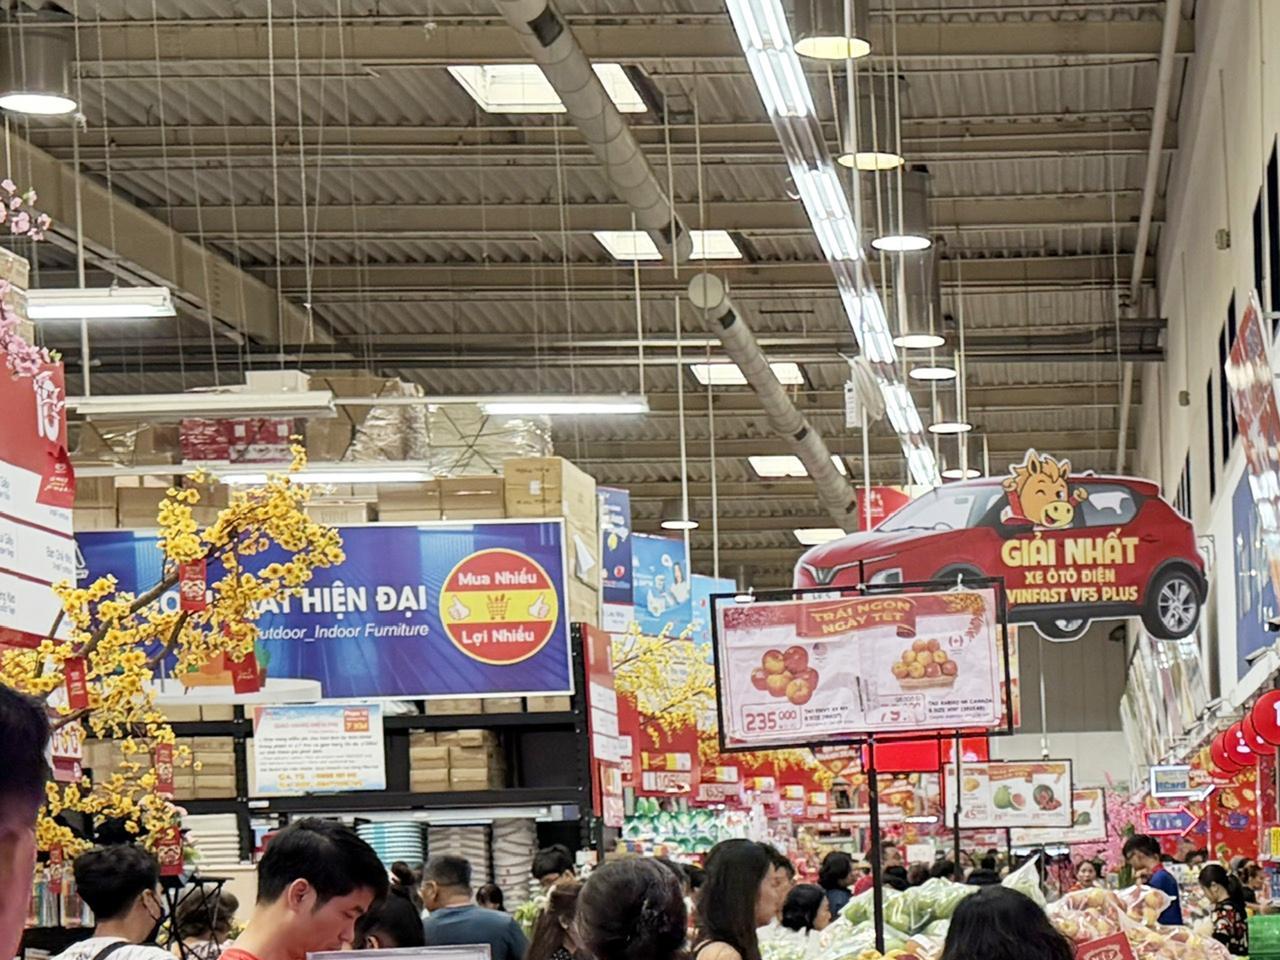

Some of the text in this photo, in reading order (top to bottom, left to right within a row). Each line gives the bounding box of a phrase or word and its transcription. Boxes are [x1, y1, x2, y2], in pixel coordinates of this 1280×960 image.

[1001, 528, 1140, 567] GIẢI NHẤT
[458, 572, 491, 586] Mua
[1024, 570, 1043, 585] XE
[302, 580, 367, 620] HIỆN
[375, 585, 427, 618] ĐẠI
[1006, 585, 1138, 604] VINFAST VF5 PLUS
[364, 622, 430, 638] Furniture
[461, 629, 488, 647] Lợi
